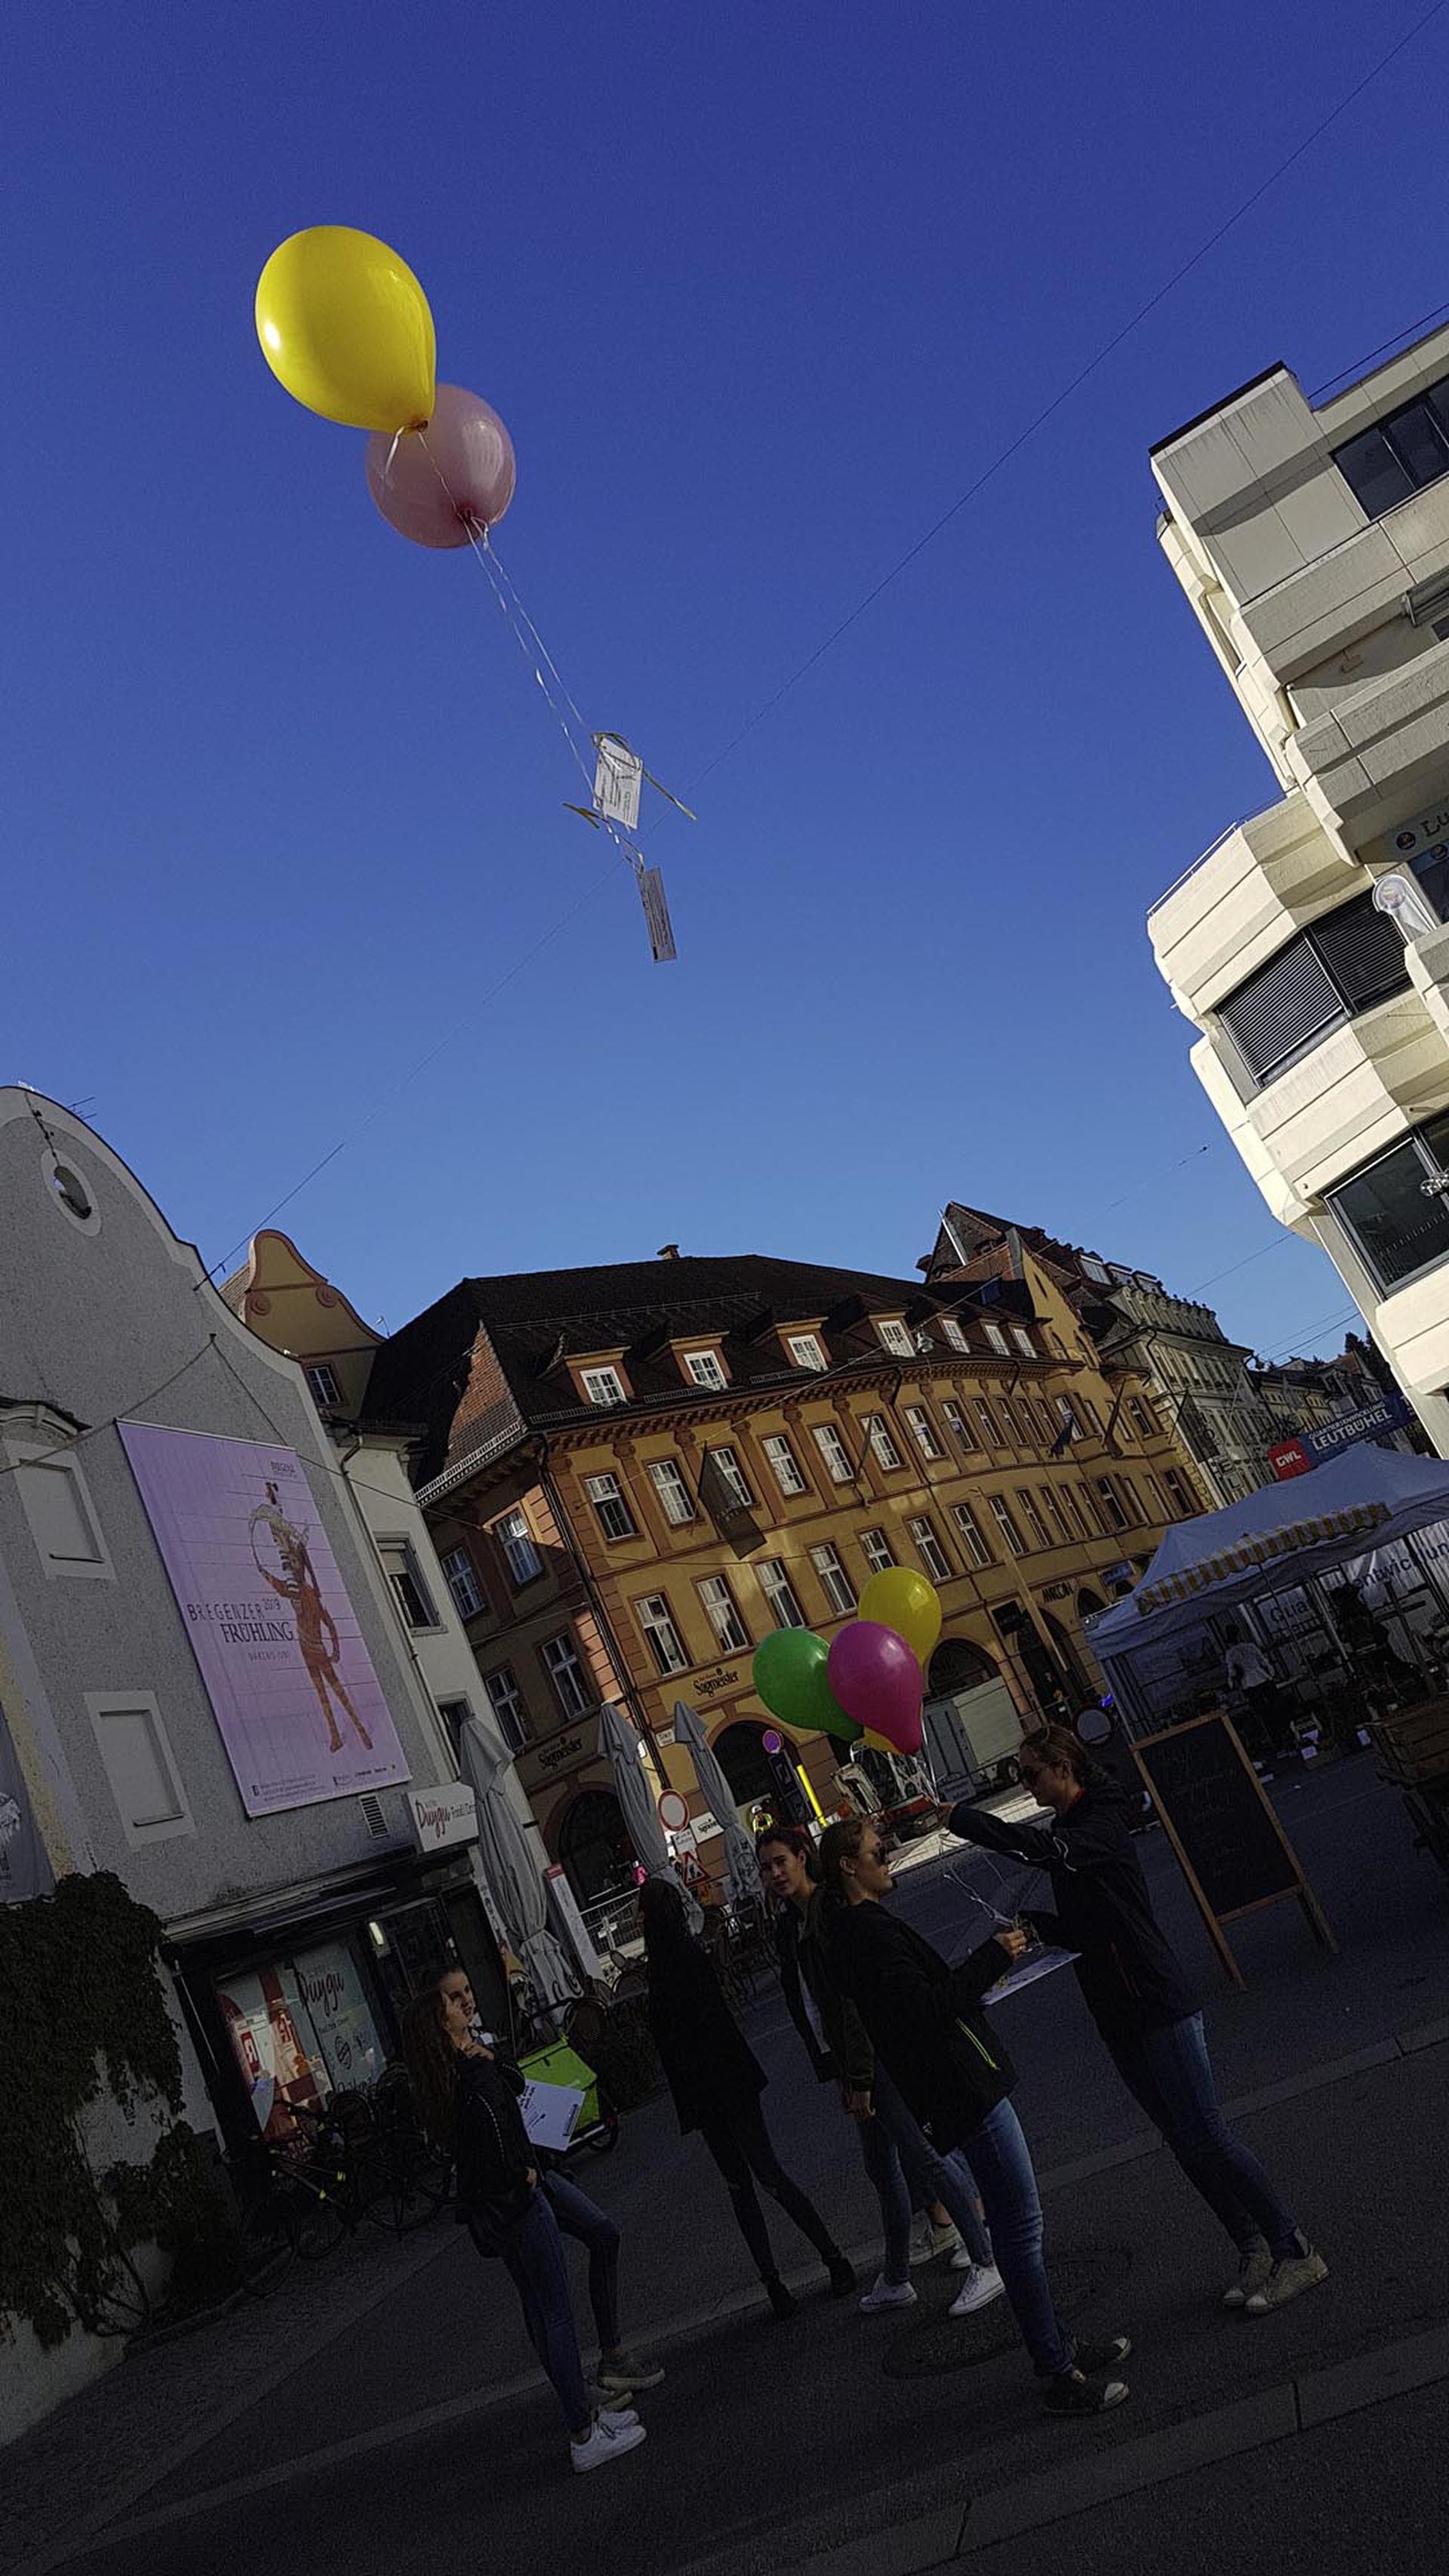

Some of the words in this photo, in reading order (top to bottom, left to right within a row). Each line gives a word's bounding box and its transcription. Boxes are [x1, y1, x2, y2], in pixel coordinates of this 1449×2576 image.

[1311, 1408, 1394, 1452] LEUTBÜHEL
[1275, 1449, 1302, 1467] GWL
[186, 1602, 265, 1621] BREGENZER
[693, 1670, 739, 1698] Sagmeister
[537, 1737, 582, 1771] Sagmeister
[415, 1800, 451, 1838] Duygu
